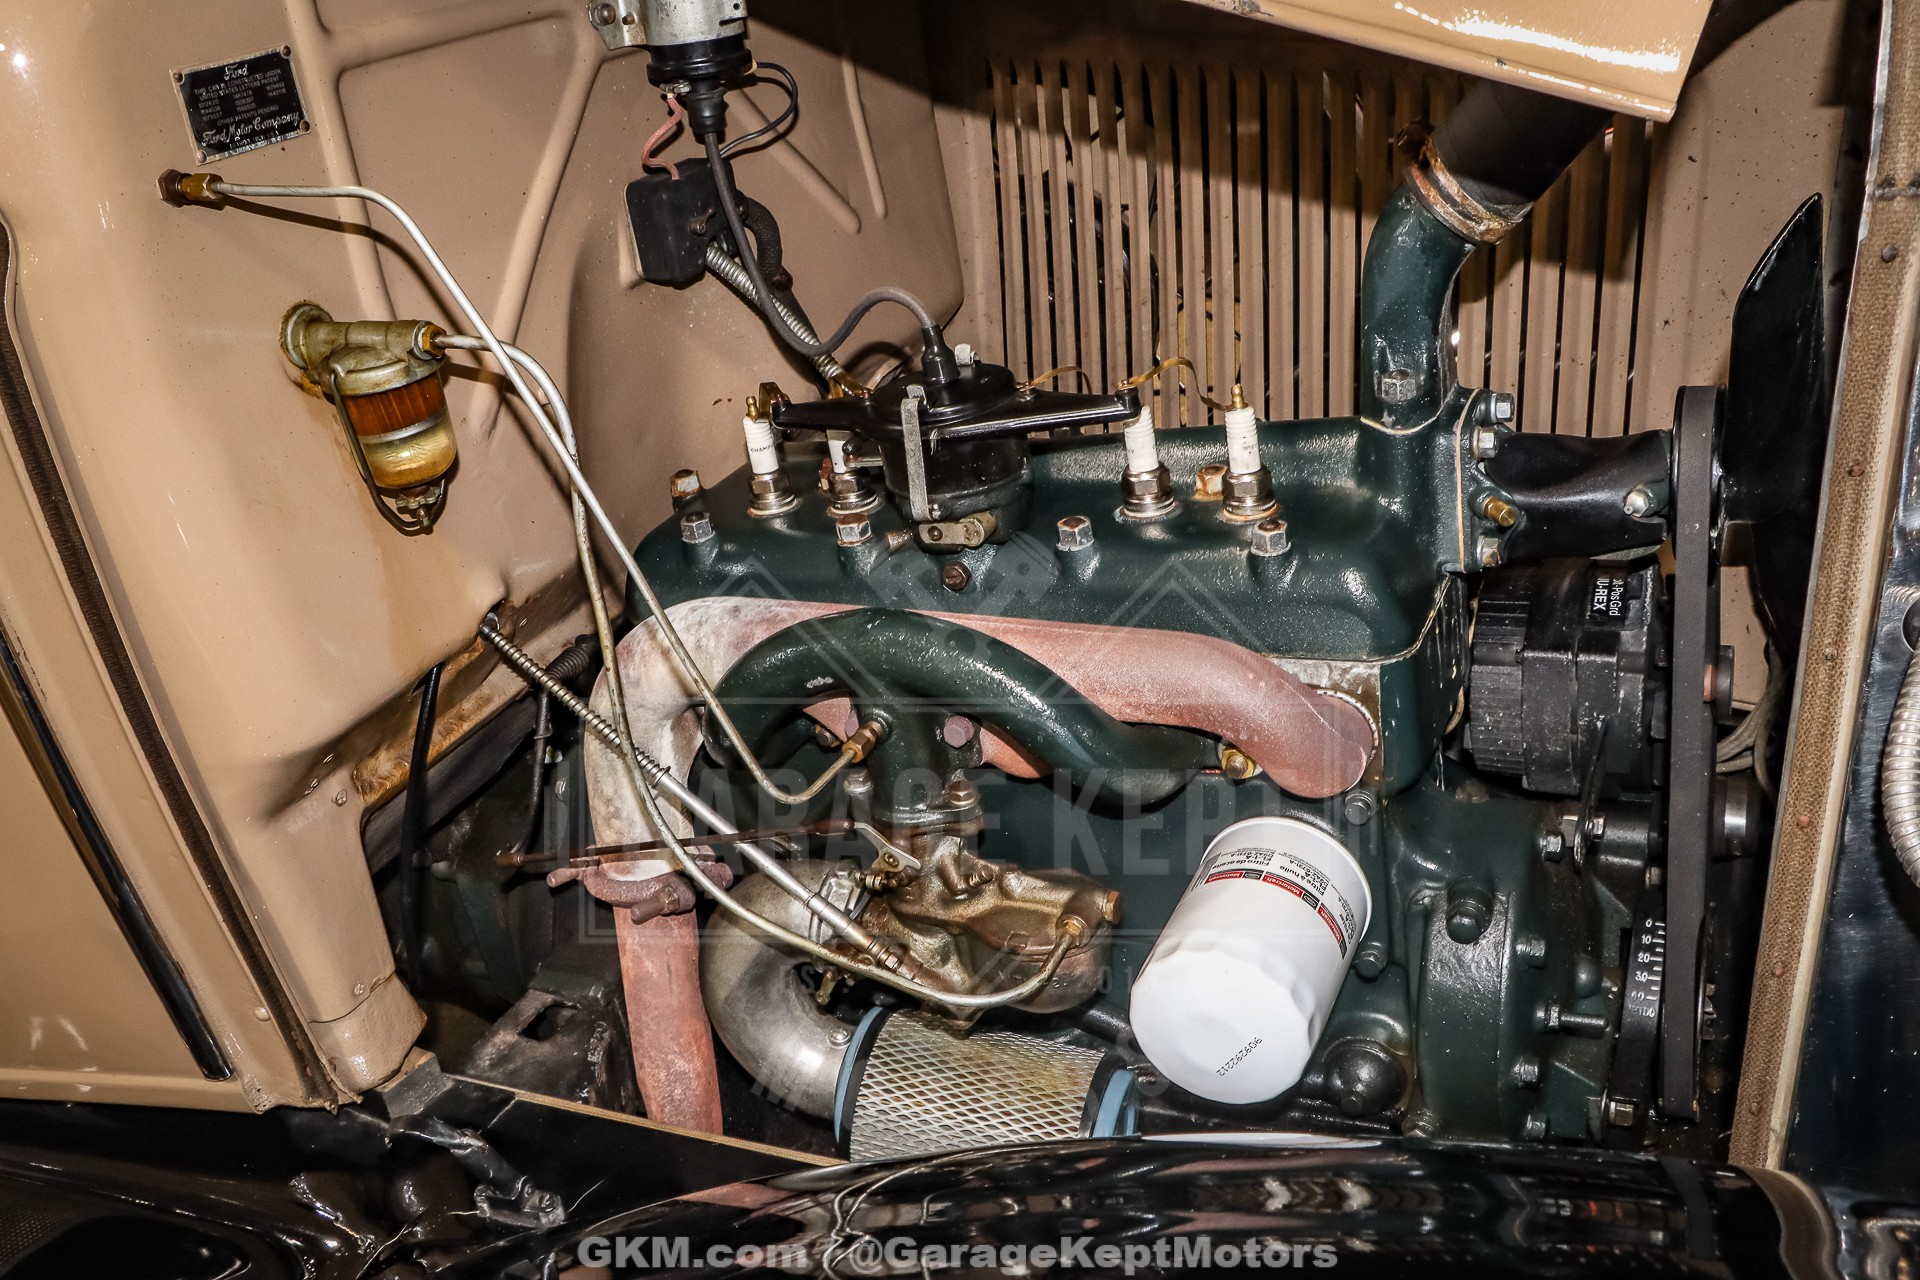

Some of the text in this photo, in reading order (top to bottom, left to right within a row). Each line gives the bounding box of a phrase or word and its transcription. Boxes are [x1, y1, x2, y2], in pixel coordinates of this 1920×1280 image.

[208, 84, 220, 92] CAR
[227, 74, 264, 87] CONSTRUCTED
[264, 69, 281, 77] UNDER
[224, 63, 248, 81] Ford
[199, 76, 279, 101] UNITED STATES LETTERS PATENT
[216, 106, 279, 126] OTHER PATENTS PENDING
[201, 126, 229, 147] Ford
[227, 124, 253, 143] Motor
[253, 111, 299, 131] Company
[1247, 859, 1269, 867] Filtro
[1266, 876, 1300, 895] Motorcraft
[1307, 878, 1324, 896] Filtre
[1645, 918, 1653, 928] 0
[1641, 934, 1652, 945] 10
[1637, 951, 1650, 963] 20
[1635, 970, 1648, 982] 30
